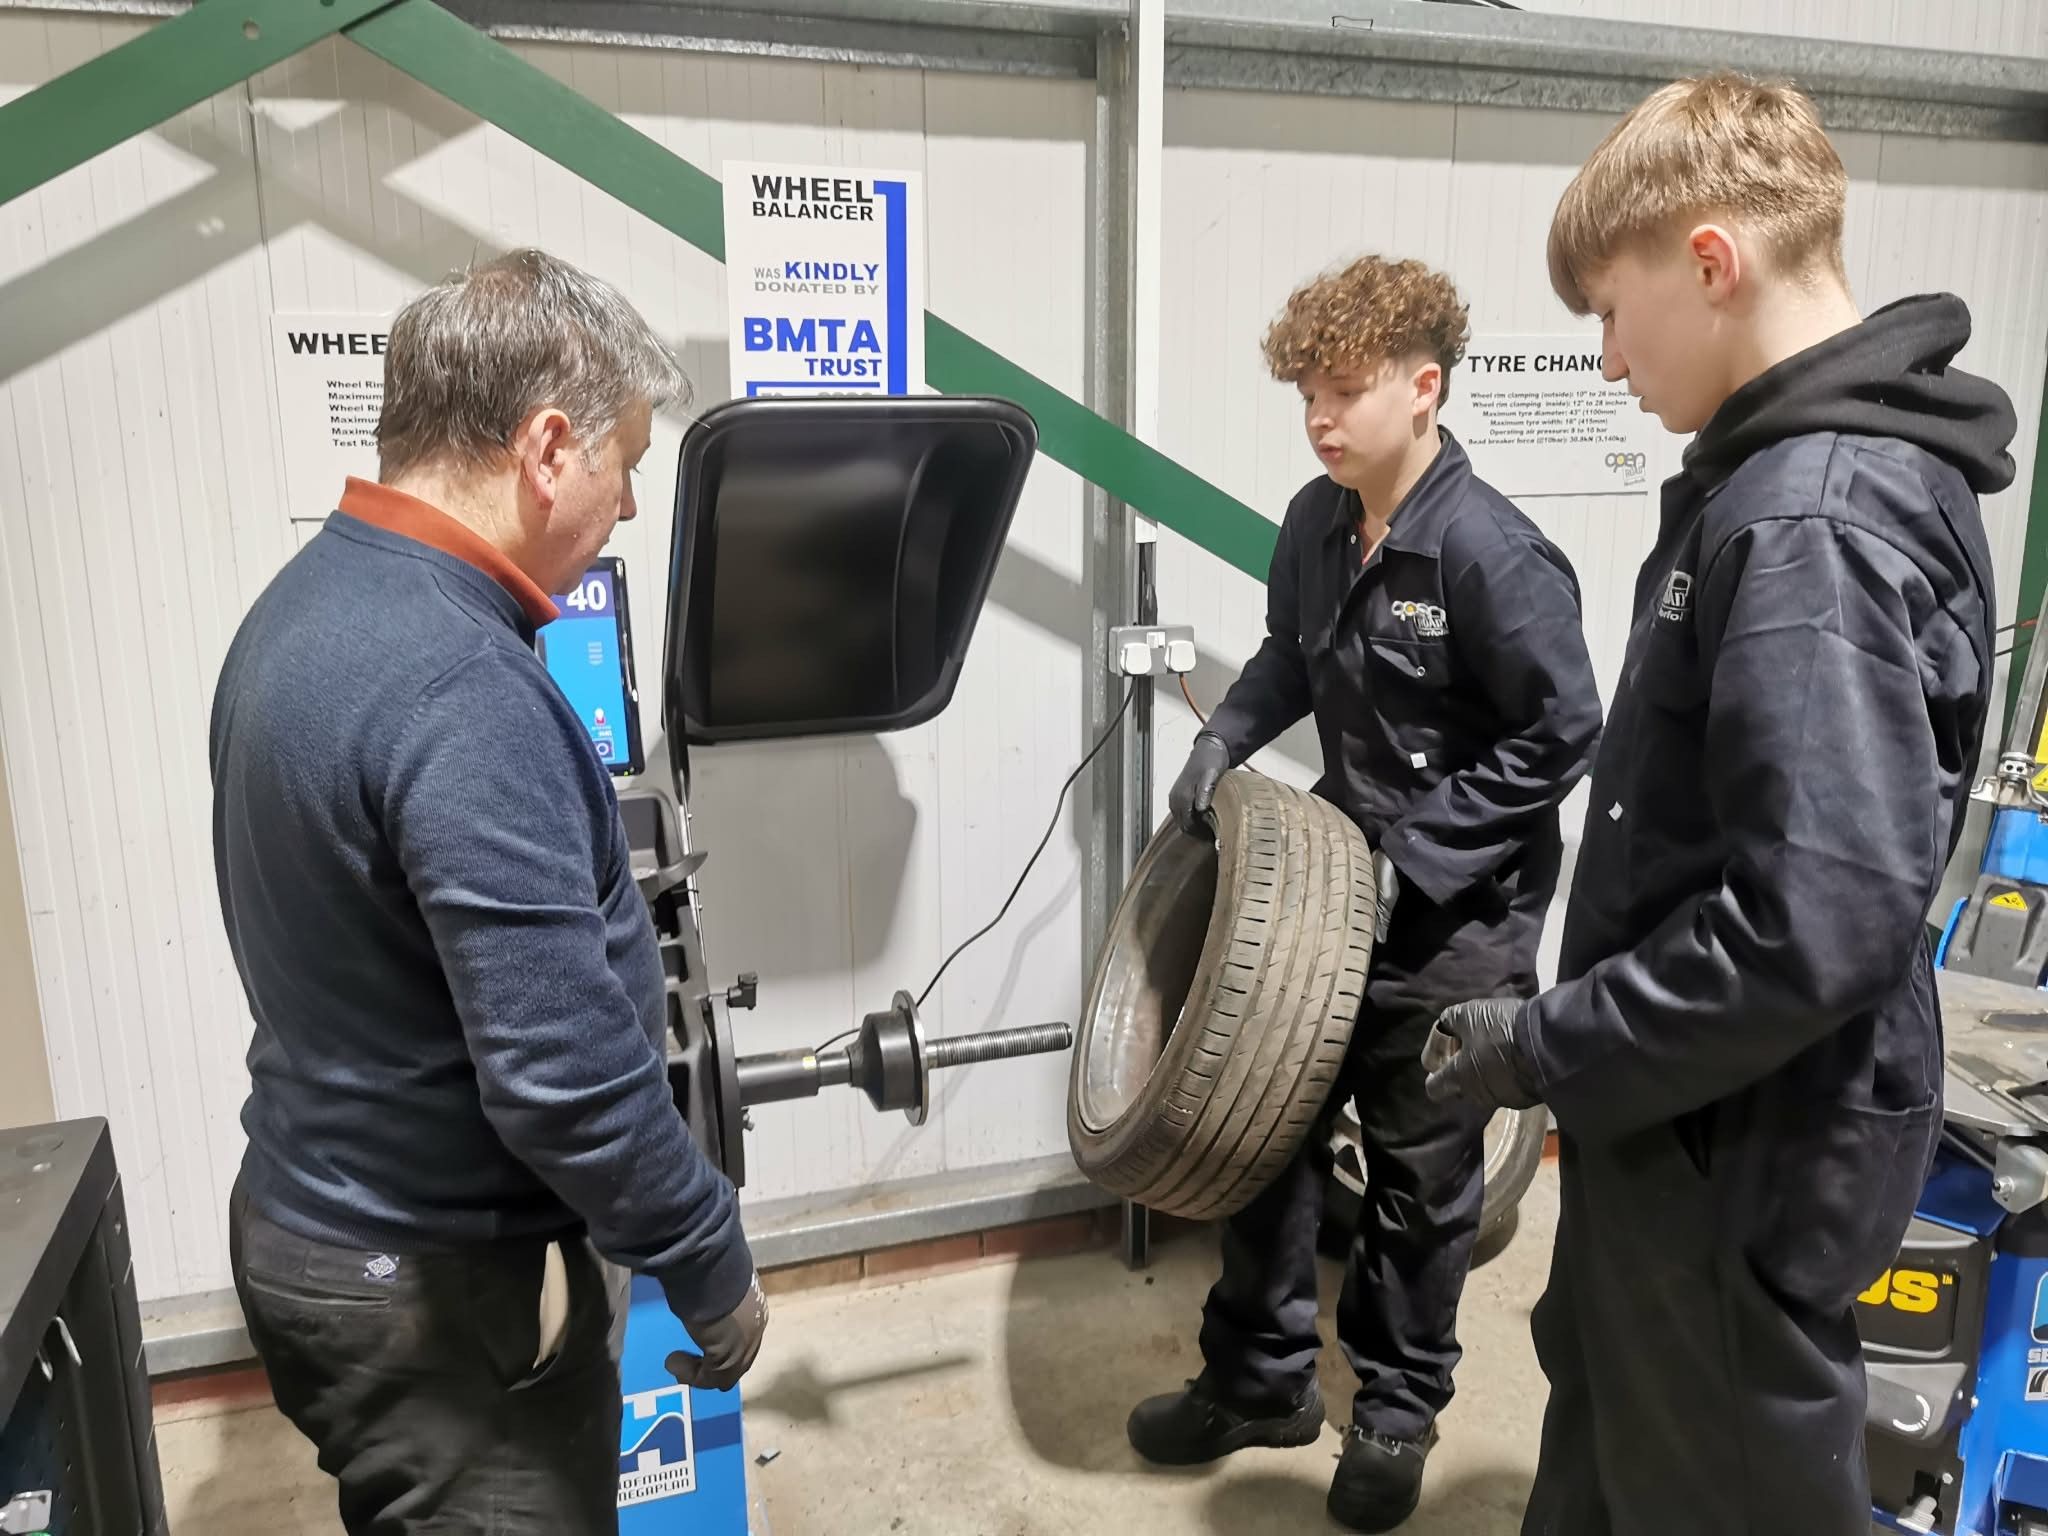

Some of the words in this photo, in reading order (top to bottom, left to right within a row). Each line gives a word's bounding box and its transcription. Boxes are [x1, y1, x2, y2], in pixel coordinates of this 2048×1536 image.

[752, 174, 873, 203] WHEEL
[752, 201, 874, 221] BALANCER
[754, 267, 781, 280] WAS
[784, 261, 879, 281] KINDLY
[754, 281, 847, 294] DONATED
[854, 285, 879, 295] BY
[744, 317, 881, 353] BMTA
[804, 358, 882, 377] TRUST
[1468, 355, 1526, 373] TYRE
[327, 380, 361, 388] Wheel
[329, 392, 382, 400] Maximum
[329, 403, 363, 411] Wheel
[332, 438, 356, 446] Test
[566, 580, 607, 611] 40
[619, 1467, 689, 1490] OFMANN
